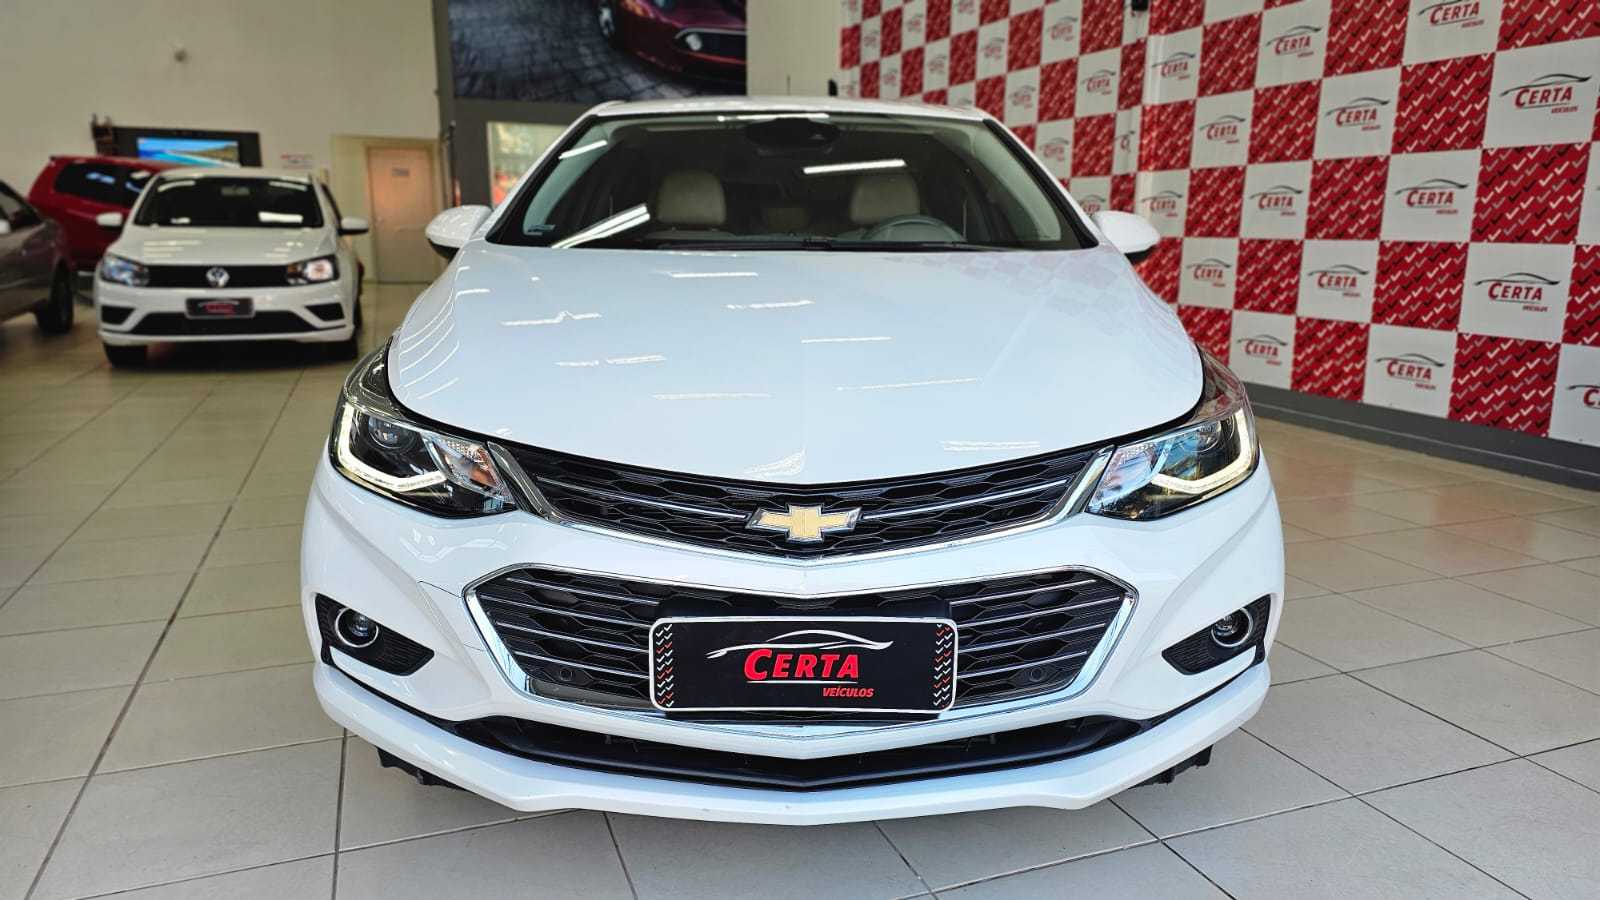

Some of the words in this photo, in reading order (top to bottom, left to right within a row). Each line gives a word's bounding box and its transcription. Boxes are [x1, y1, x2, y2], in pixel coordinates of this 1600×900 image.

[1430, 2, 1479, 24] CERTA
[1514, 87, 1573, 108] CERTA
[1336, 108, 1377, 126] CERTA
[1407, 190, 1454, 207] CERTA
[1317, 272, 1357, 288] CERTA
[1487, 283, 1543, 300] CERTA
[1387, 360, 1432, 379] CERTA
[743, 648, 859, 680] CERTA
[822, 685, 875, 698] VEÍCULOS
